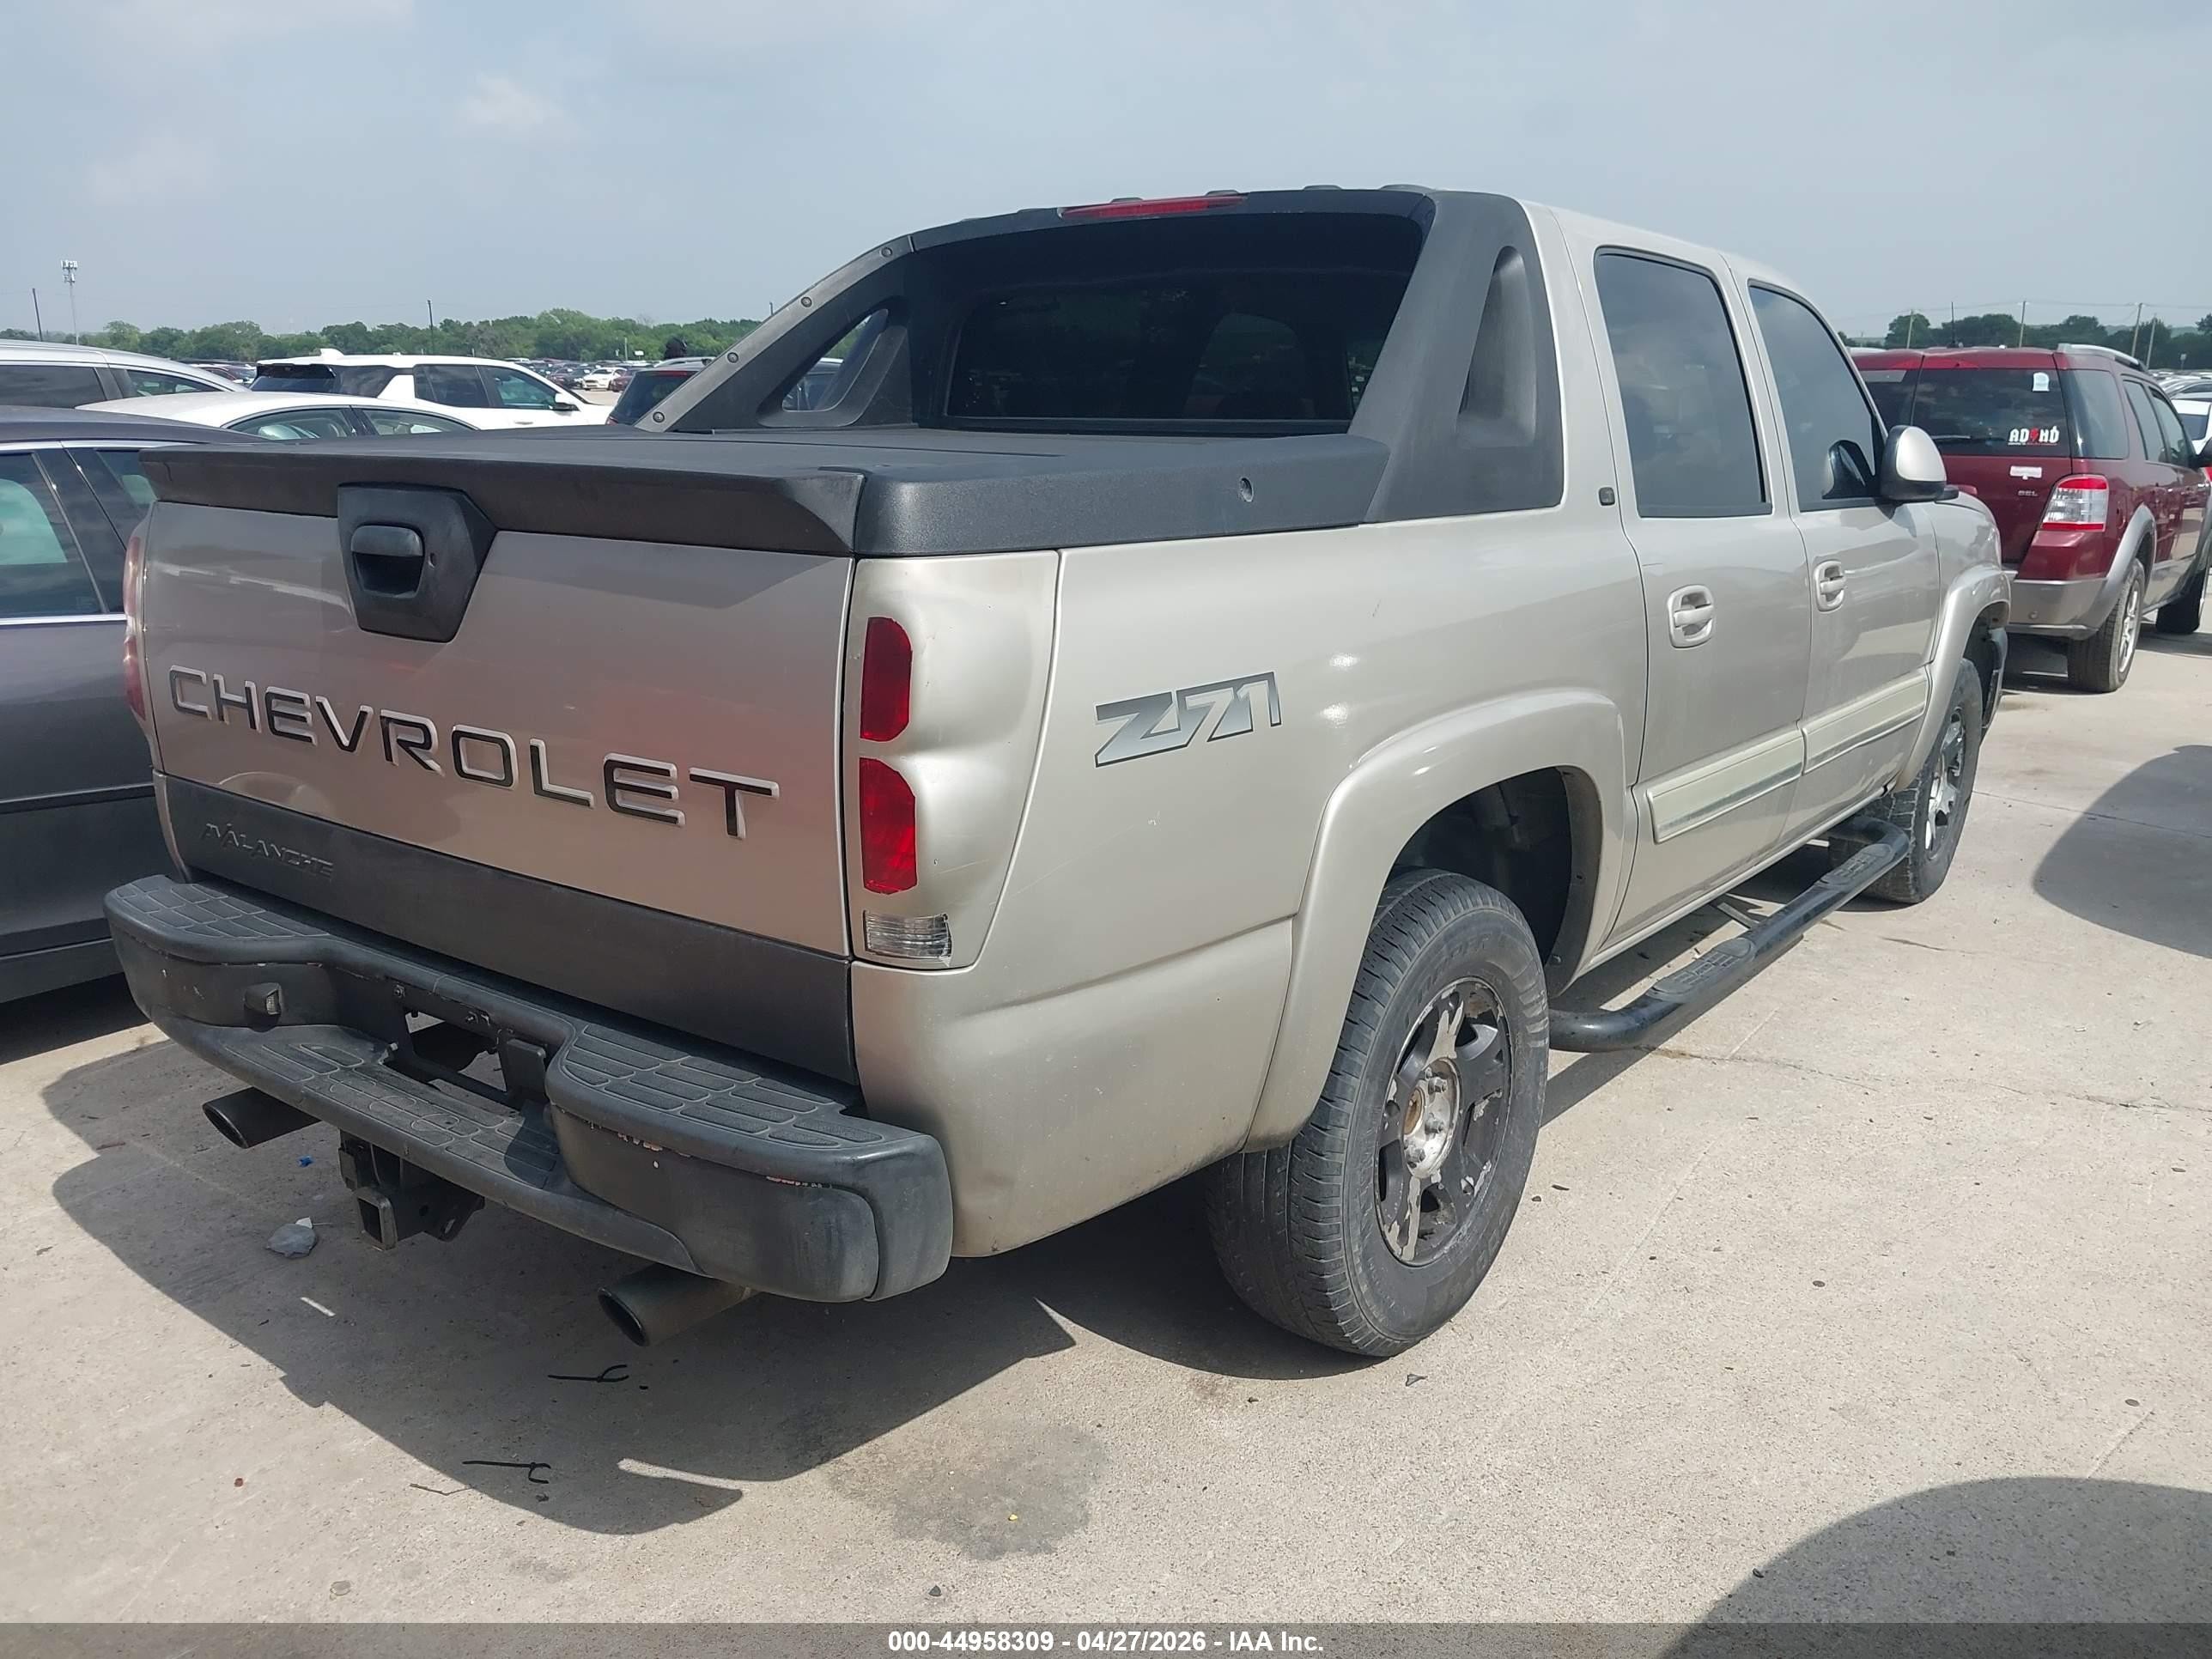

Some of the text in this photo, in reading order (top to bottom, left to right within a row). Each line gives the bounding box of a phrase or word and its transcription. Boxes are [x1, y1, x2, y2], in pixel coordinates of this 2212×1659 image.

[169, 665, 780, 840] CHEVROLET
[1094, 670, 1283, 768] Z71
[200, 822, 334, 882] AVALANCHE
